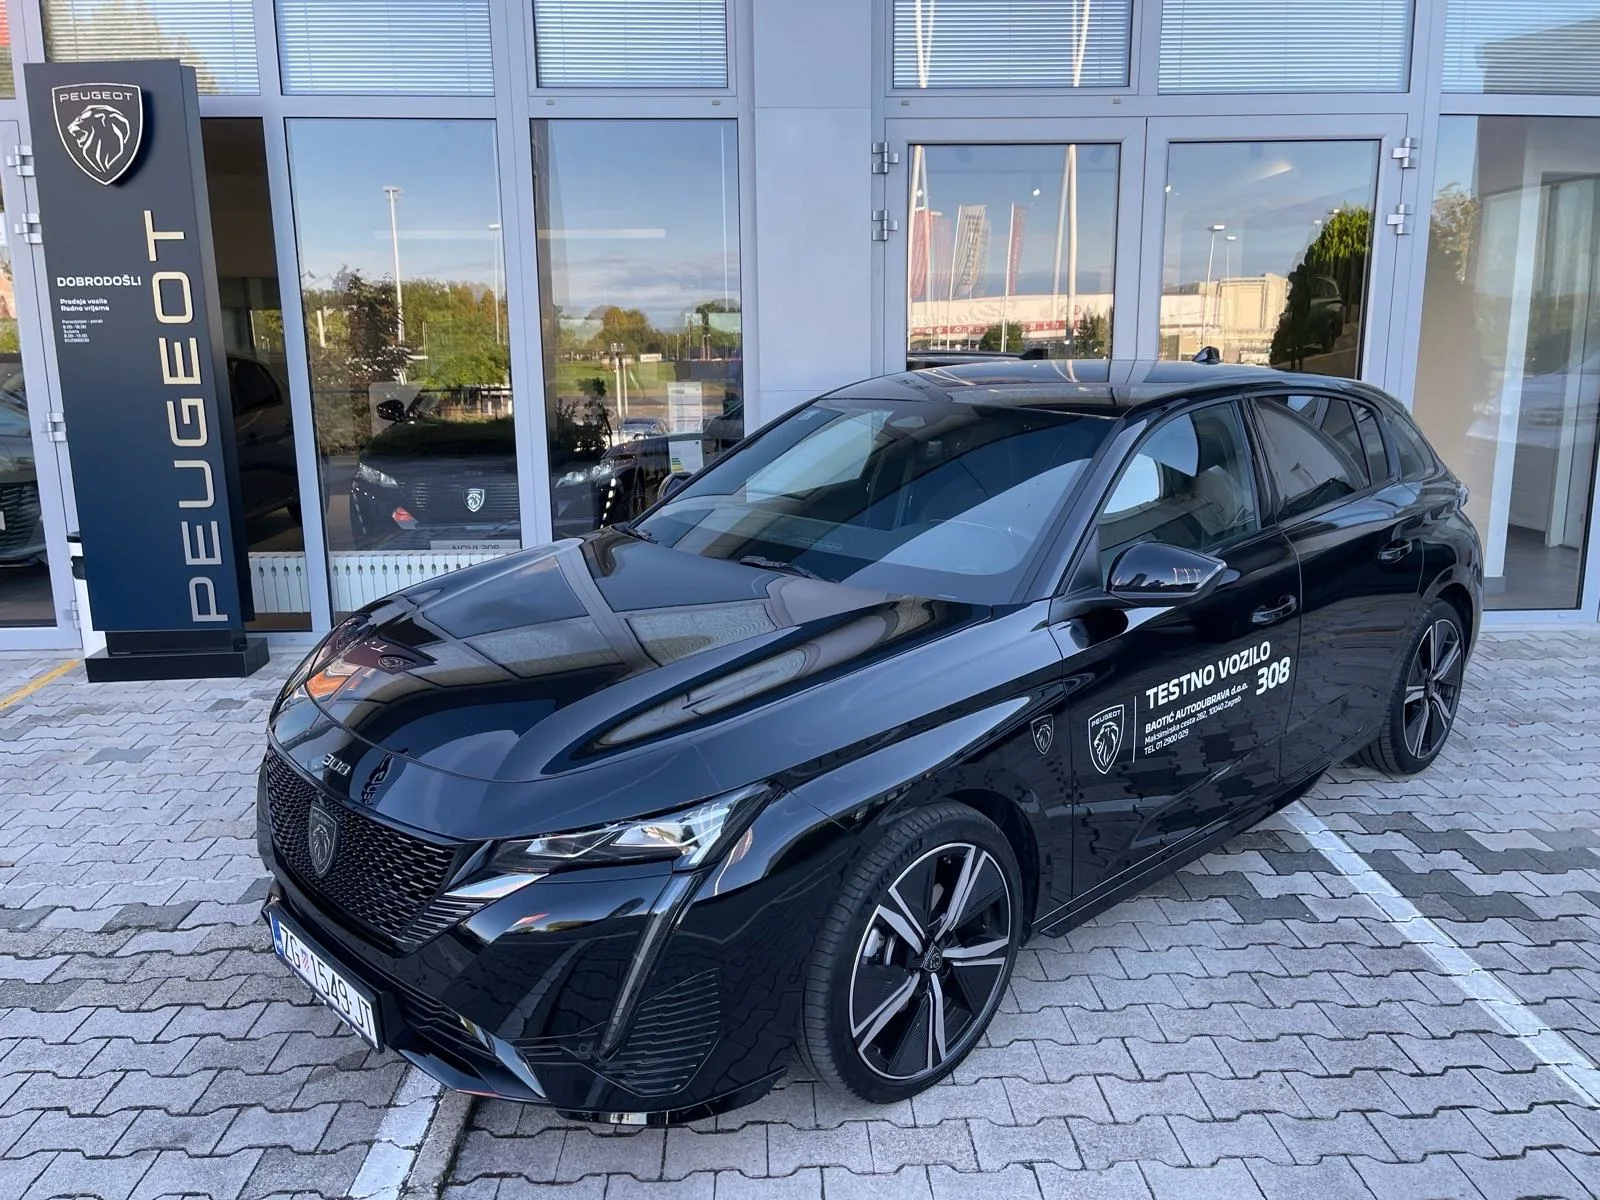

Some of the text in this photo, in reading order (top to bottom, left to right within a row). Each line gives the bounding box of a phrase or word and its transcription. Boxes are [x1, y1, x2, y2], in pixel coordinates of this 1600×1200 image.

[60, 91, 133, 102] PEUGEOT
[56, 274, 142, 287] DOBRODOŠLI
[143, 210, 229, 622] PEUGEOT
[1146, 641, 1271, 710] TESTNO VOZILO
[1256, 656, 1291, 696] 308
[1144, 724, 1180, 745] Maksimirska
[1180, 717, 1195, 728] cesta
[1145, 711, 1174, 734] BAOTIĆ
[1175, 688, 1230, 720] AUTODUBRAVA
[1144, 745, 1155, 755] TEL
[1155, 740, 1163, 750] 01
[280, 926, 301, 969] ZG
